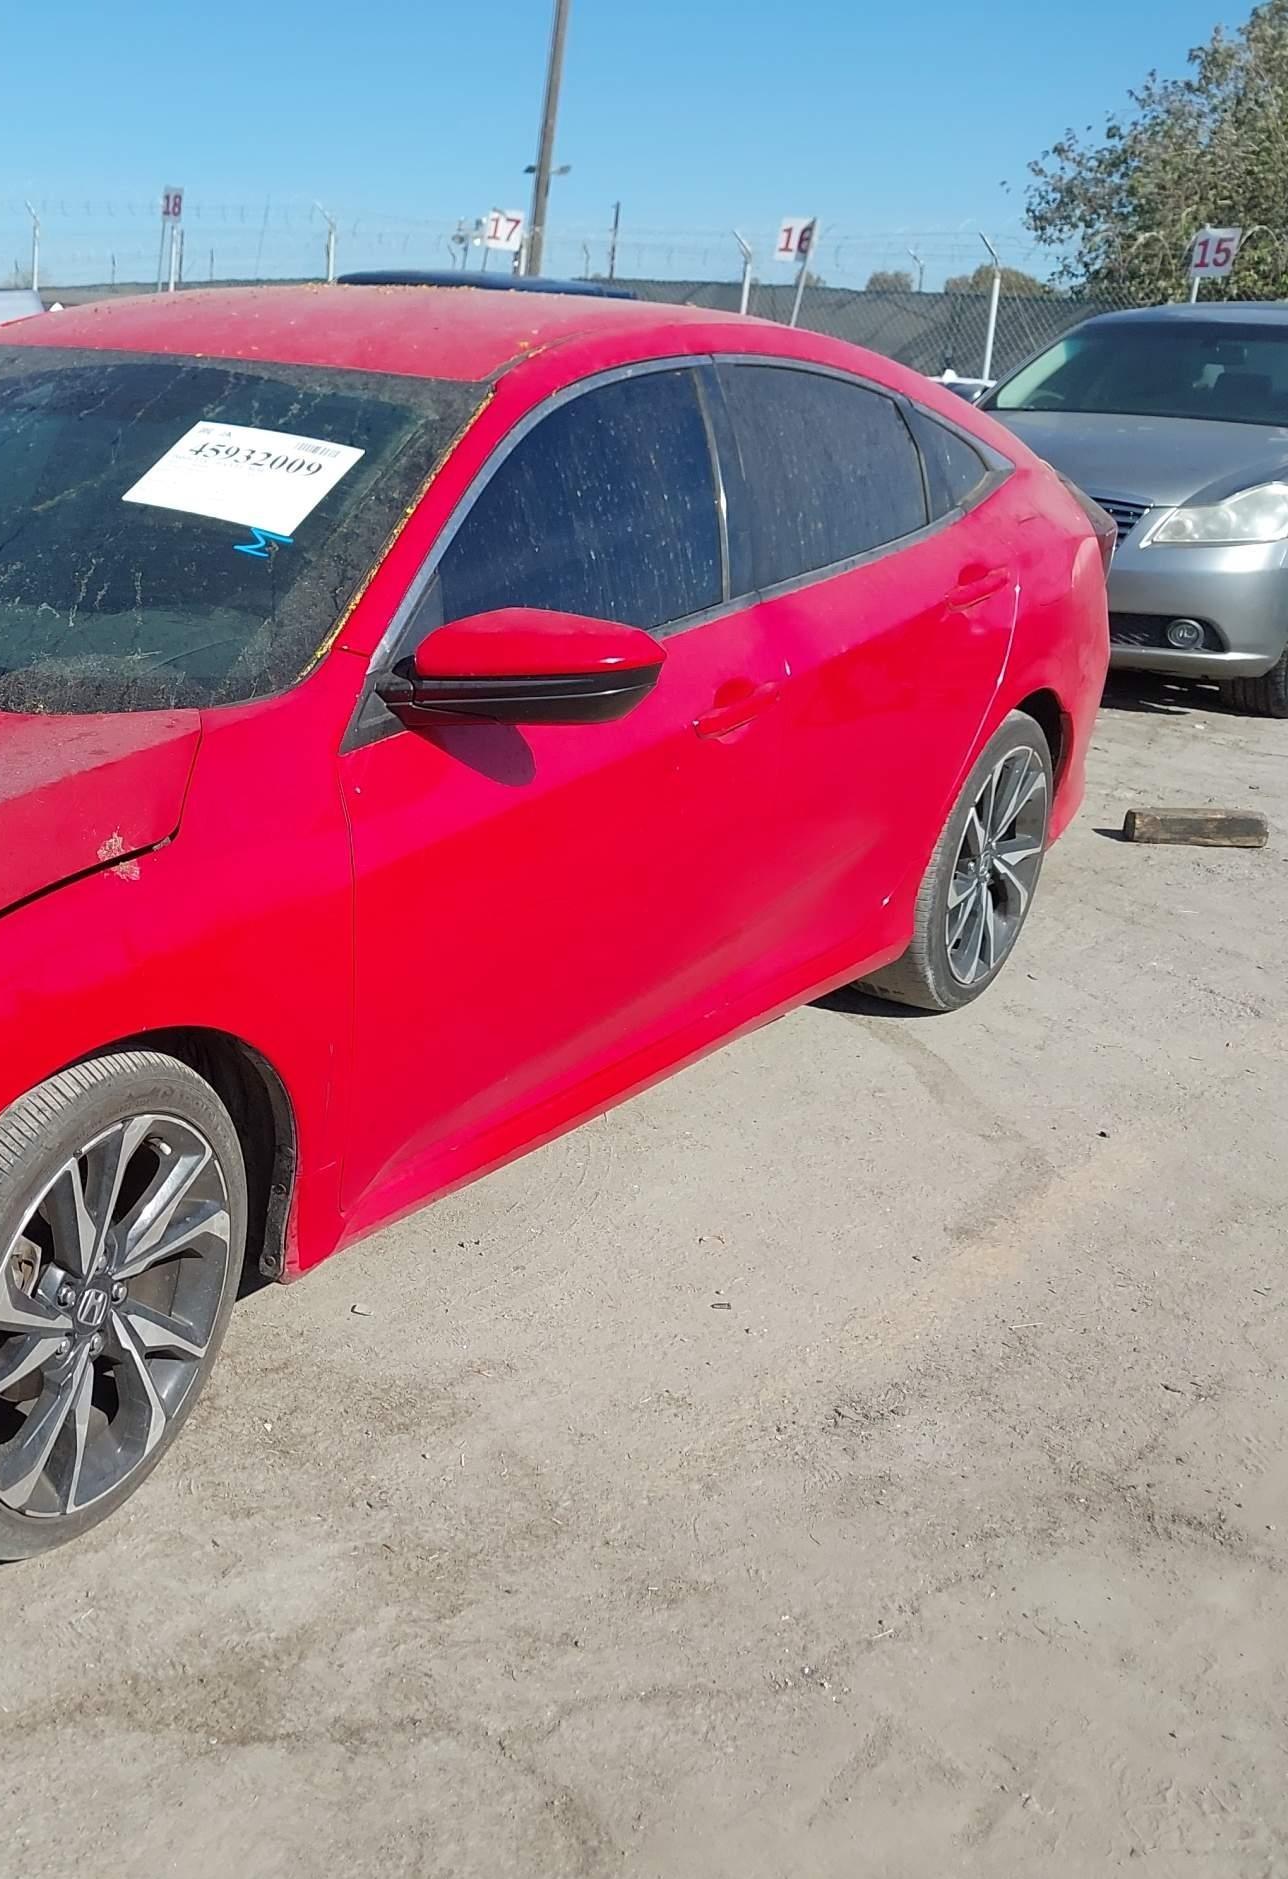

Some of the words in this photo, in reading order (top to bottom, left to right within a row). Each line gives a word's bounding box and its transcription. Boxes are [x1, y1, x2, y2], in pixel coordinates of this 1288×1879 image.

[163, 193, 182, 217] 18
[488, 216, 521, 242] 17
[778, 225, 813, 254] 16
[1194, 236, 1235, 268] 15
[189, 441, 325, 476] 45932009
